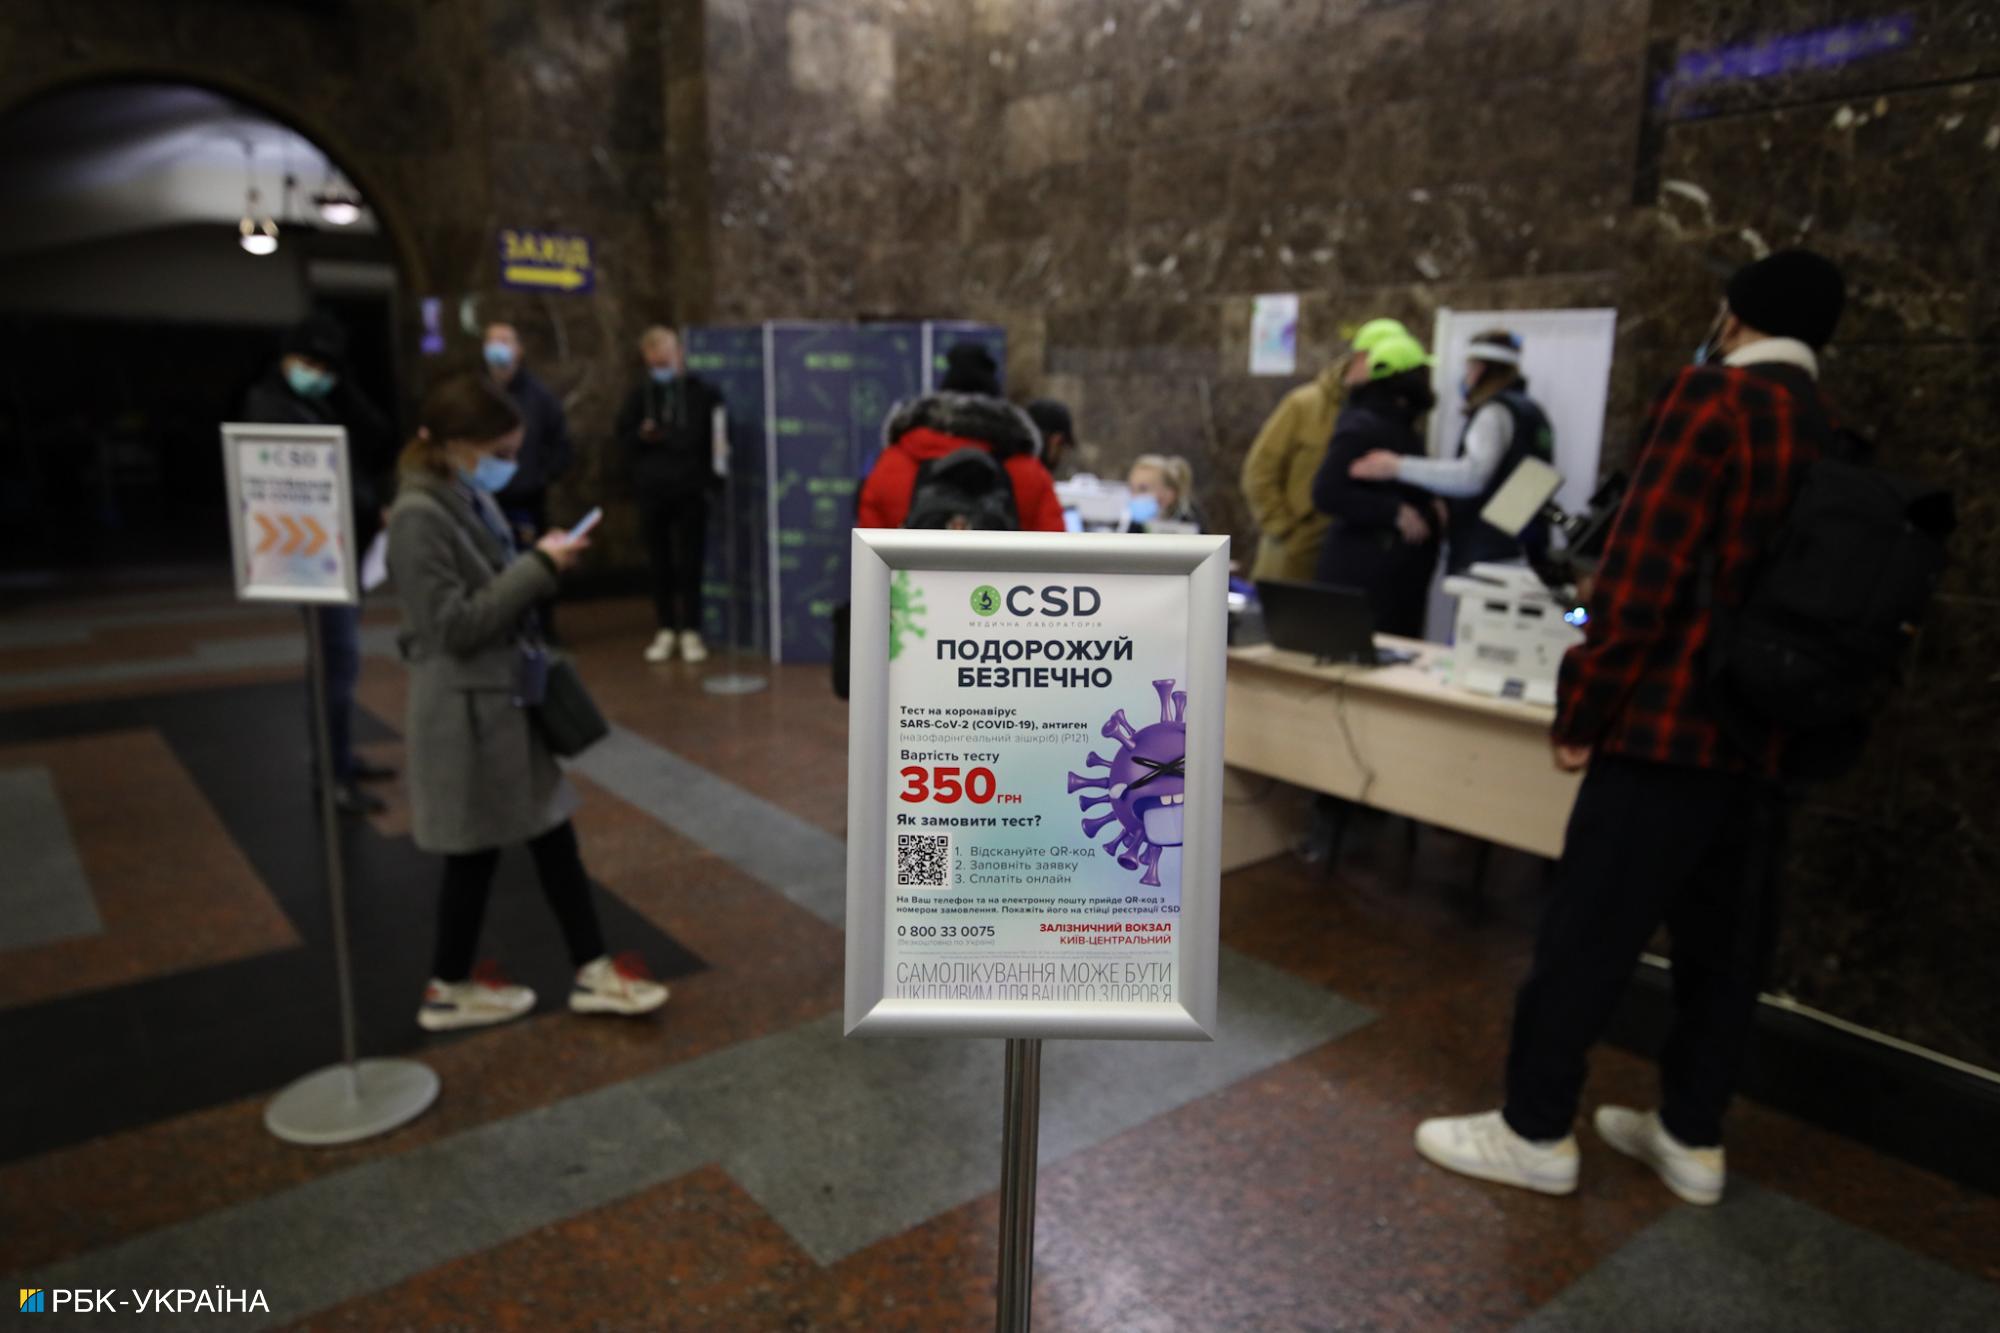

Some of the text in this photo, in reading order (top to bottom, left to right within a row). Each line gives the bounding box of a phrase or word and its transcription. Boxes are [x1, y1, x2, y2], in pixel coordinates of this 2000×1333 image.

[1006, 585, 1102, 617] CSD
[1026, 621, 1102, 629] ЛАБОРАТОРІЯ
[936, 636, 1133, 664] ПОДОРОЖУЙ
[957, 667, 1113, 688] БЕЗПЕЧНО
[900, 705, 1017, 718] Тест на коронавірус
[900, 719, 1088, 731] SARS-CoV-2 (COVID-19), антиген
[900, 733, 1011, 744] (назофарінгеальний
[1015, 733, 1059, 744] зішкріб)
[900, 750, 1000, 764] Вартість тесту
[899, 765, 1022, 804] 350 ГРН
[896, 814, 1042, 827] Як замовити тест?
[954, 846, 1096, 859] 1. Відскануйте QR-код
[954, 860, 1079, 872] 2. Заповніть заявку
[954, 873, 1072, 884] 3. Сплатіть онлайн
[911, 896, 931, 904] Ваш
[934, 896, 974, 905] телефон
[1001, 897, 1055, 905] електронну
[1058, 897, 1086, 905] пошту
[1089, 896, 1123, 905] прийде
[1125, 896, 1158, 905] QR-код
[896, 906, 938, 915] номером
[1001, 906, 1044, 914] Покажіть
[1046, 906, 1069, 914] його
[1084, 906, 1110, 914] стійці
[1112, 906, 1159, 914] реєстрації
[1160, 905, 1181, 913] CSD
[897, 925, 995, 937] 0 800 33 0075
[1039, 922, 1172, 932] ЗАЛІЗНИЧНИЙ ВОКЗАЛ
[1060, 934, 1172, 945] КИЇВ-ЦЕНТРАЛЬНИЙ
[896, 962, 1172, 984] САМОЛІКУВАННЯ МОЖЕ БУТИ
